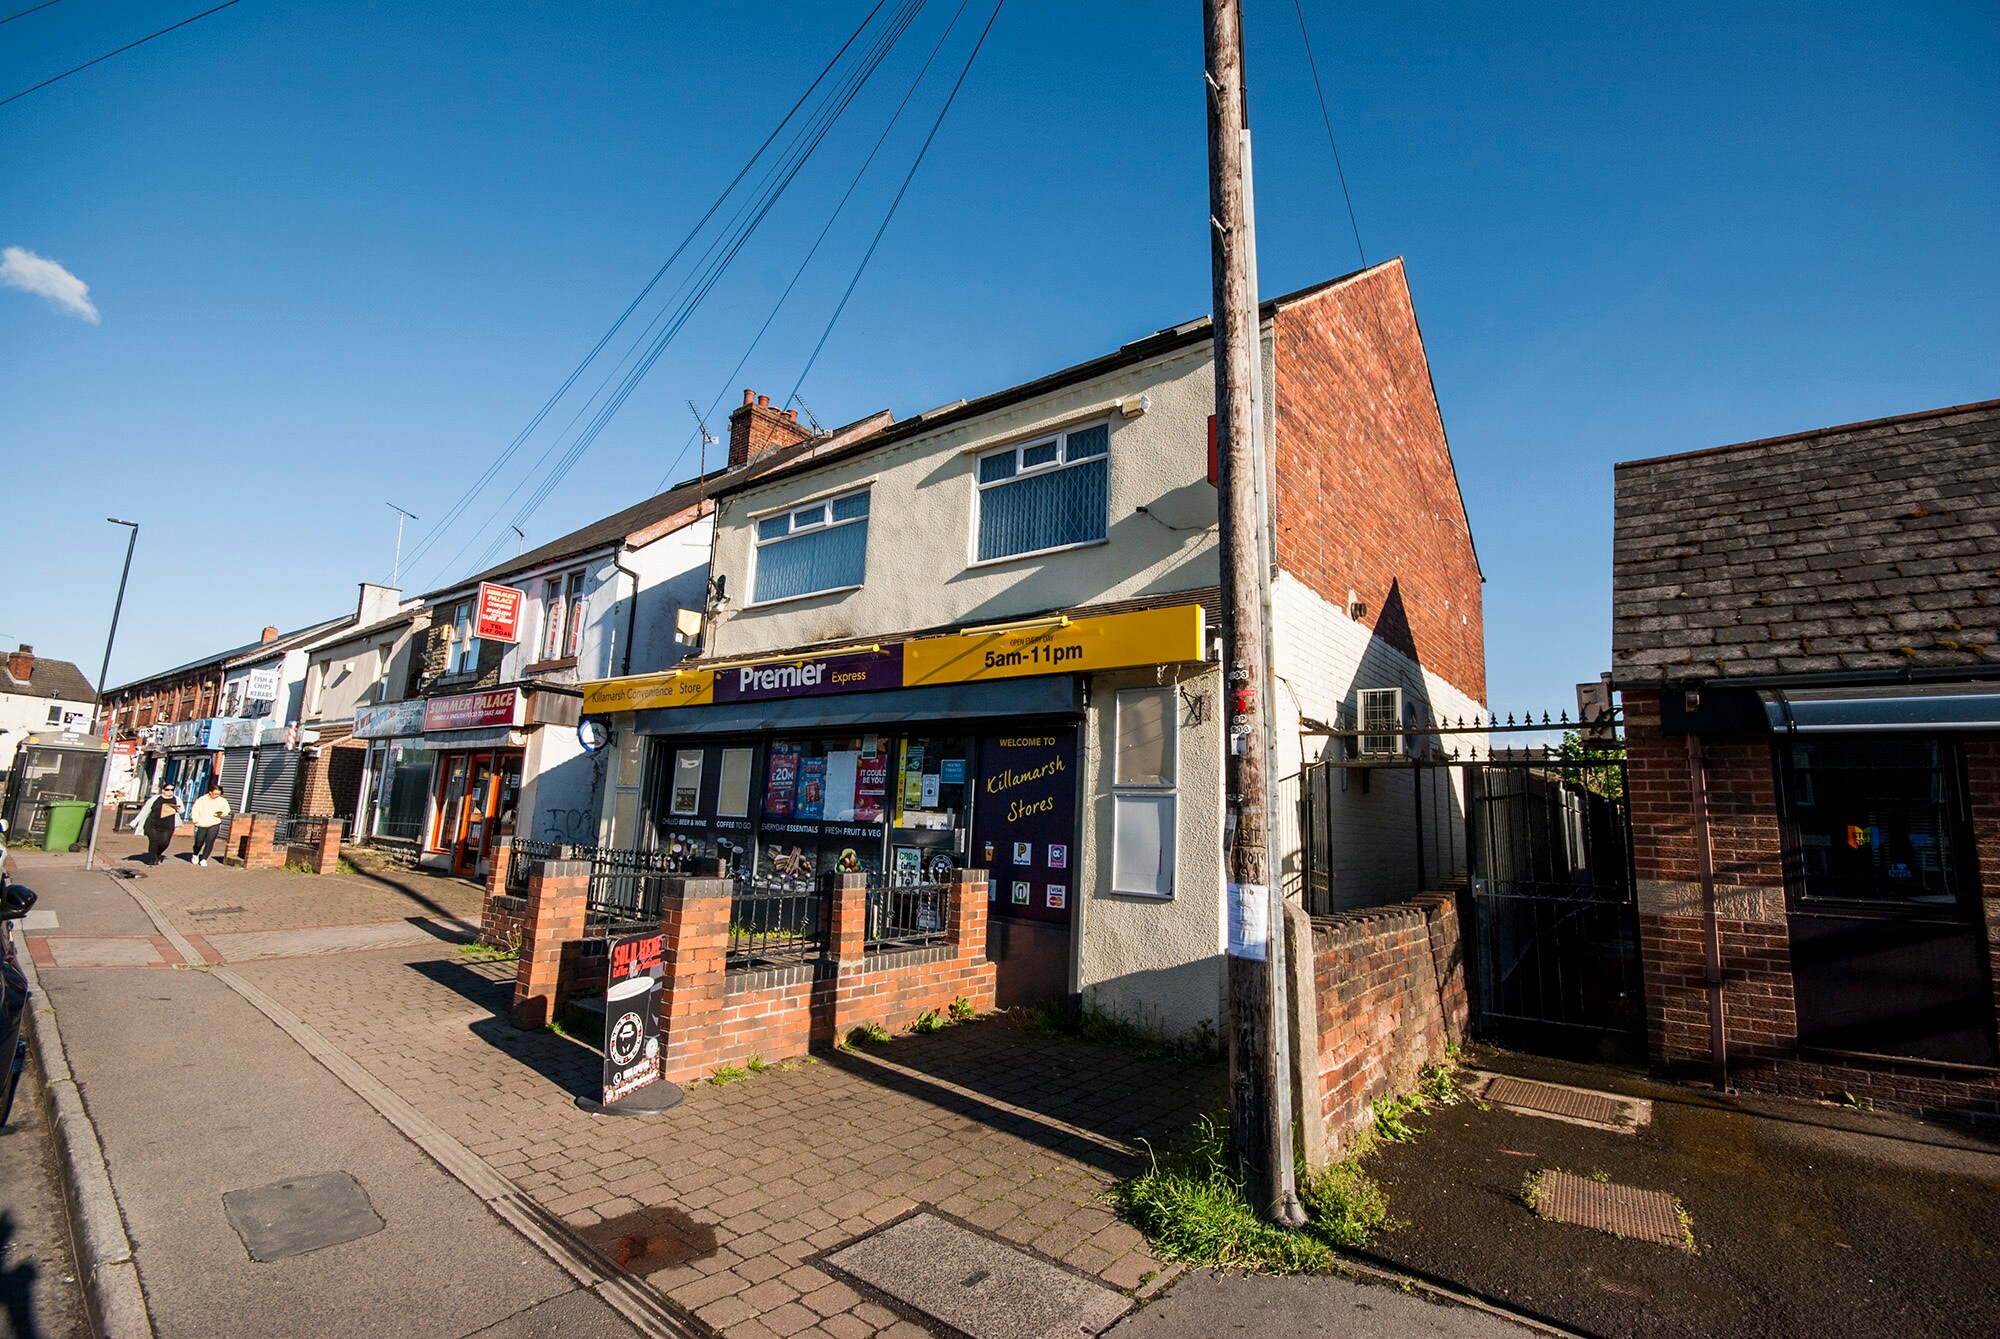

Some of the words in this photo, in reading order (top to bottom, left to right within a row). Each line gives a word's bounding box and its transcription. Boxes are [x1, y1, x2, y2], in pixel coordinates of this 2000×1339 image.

[486, 589, 517, 600] SUMMER
[488, 595, 513, 605] PALACE
[487, 601, 512, 610] CHINESE
[482, 613, 497, 622] TAKE
[496, 617, 514, 625] AWAY
[1010, 638, 1024, 647] OPEN
[1025, 636, 1042, 646] EVERY
[1043, 634, 1054, 643] DAY
[984, 643, 1083, 668] 5am-11pm
[739, 662, 827, 692] Premier
[831, 671, 866, 684] Express
[250, 690, 272, 698] KEBABS
[592, 686, 625, 703] Killamarsh
[626, 685, 673, 701] Convenience
[680, 682, 701, 695] Store
[430, 699, 472, 713] SUMMER
[474, 693, 514, 709] PALACE
[999, 737, 1041, 747] WELCOME
[1044, 737, 1055, 746] TO
[866, 769, 887, 777] COULD
[986, 755, 1066, 794] Killamarsh
[1007, 796, 1054, 822] Stores
[662, 817, 678, 826] CHILLED
[679, 818, 690, 827] BEER
[695, 819, 707, 828] WINE
[716, 820, 734, 829] COFFEE
[735, 821, 741, 829] TO
[742, 821, 751, 829] GO
[761, 822, 786, 832] EVERYDAY
[787, 824, 819, 834] ESSENTIALS
[825, 826, 843, 835] FRESH
[844, 827, 861, 836] FRUIT
[861, 828, 867, 837] &
[868, 828, 882, 837] VEG
[614, 942, 638, 967] SOLD
[639, 935, 662, 960] HERE
